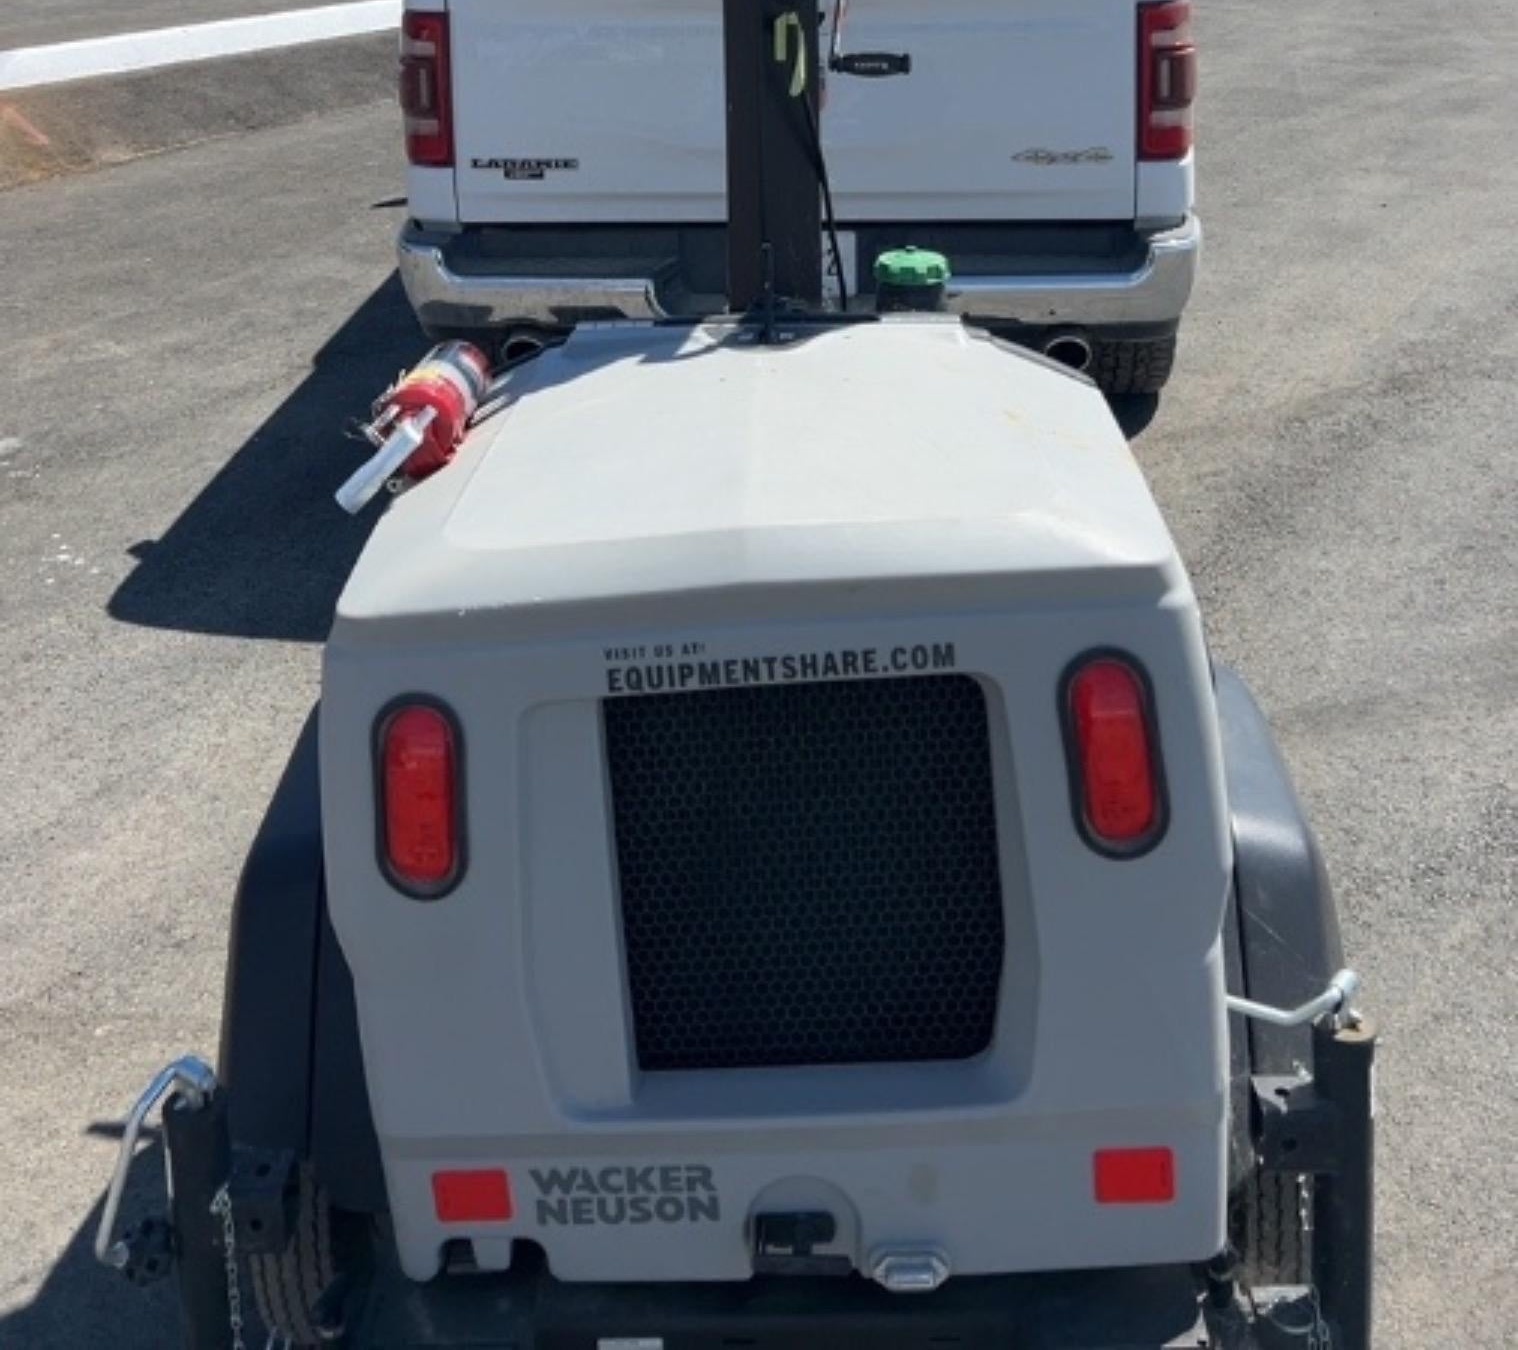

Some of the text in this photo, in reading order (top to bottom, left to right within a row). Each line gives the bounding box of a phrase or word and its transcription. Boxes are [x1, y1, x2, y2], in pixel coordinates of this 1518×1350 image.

[603, 645, 646, 661] VISIT
[653, 643, 673, 658] US
[606, 642, 956, 693] EQUIPMENTSHARE.COM
[528, 1164, 717, 1195] WACKER
[535, 1194, 720, 1226] NEUSON
